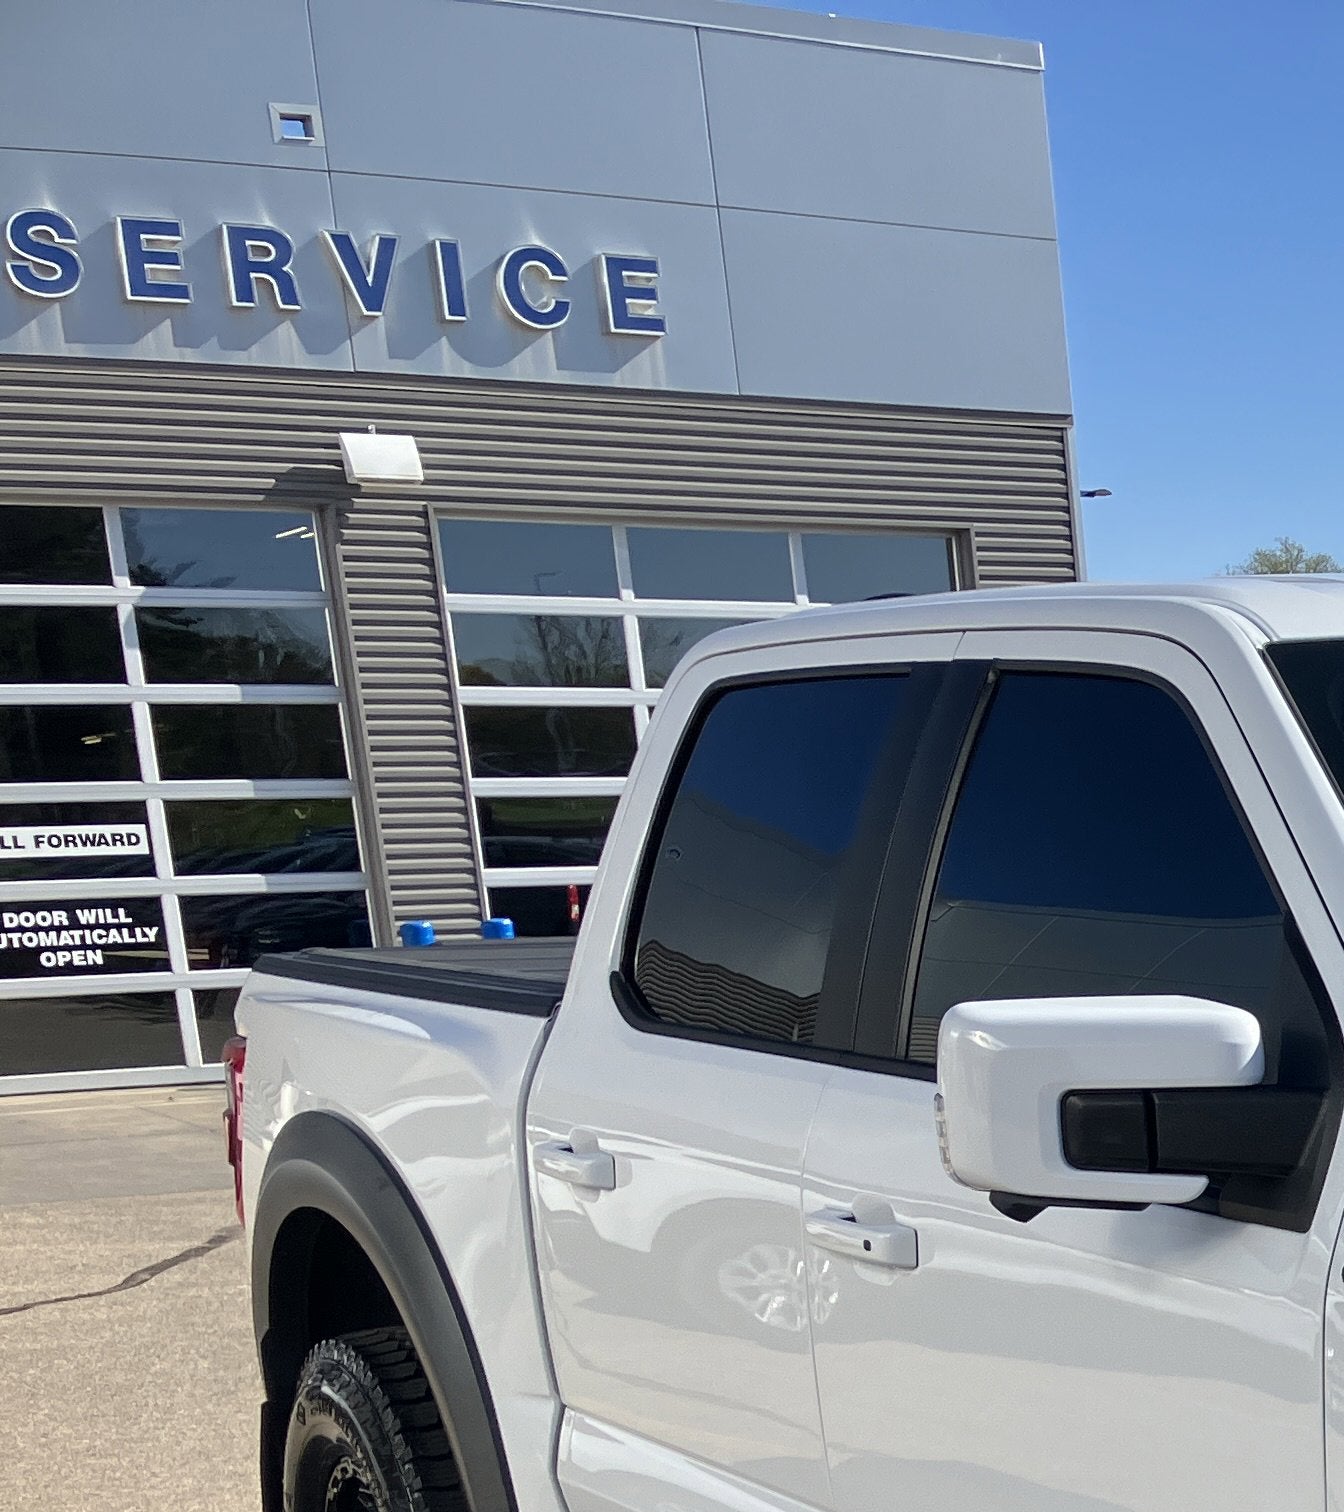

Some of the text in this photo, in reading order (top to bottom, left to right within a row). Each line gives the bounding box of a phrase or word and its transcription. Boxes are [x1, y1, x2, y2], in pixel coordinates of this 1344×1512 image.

[5, 207, 668, 337] SERVICE
[0, 832, 141, 850] LL FORWARD
[2, 907, 133, 928] DOOR WILL
[39, 949, 104, 968] OPEN
